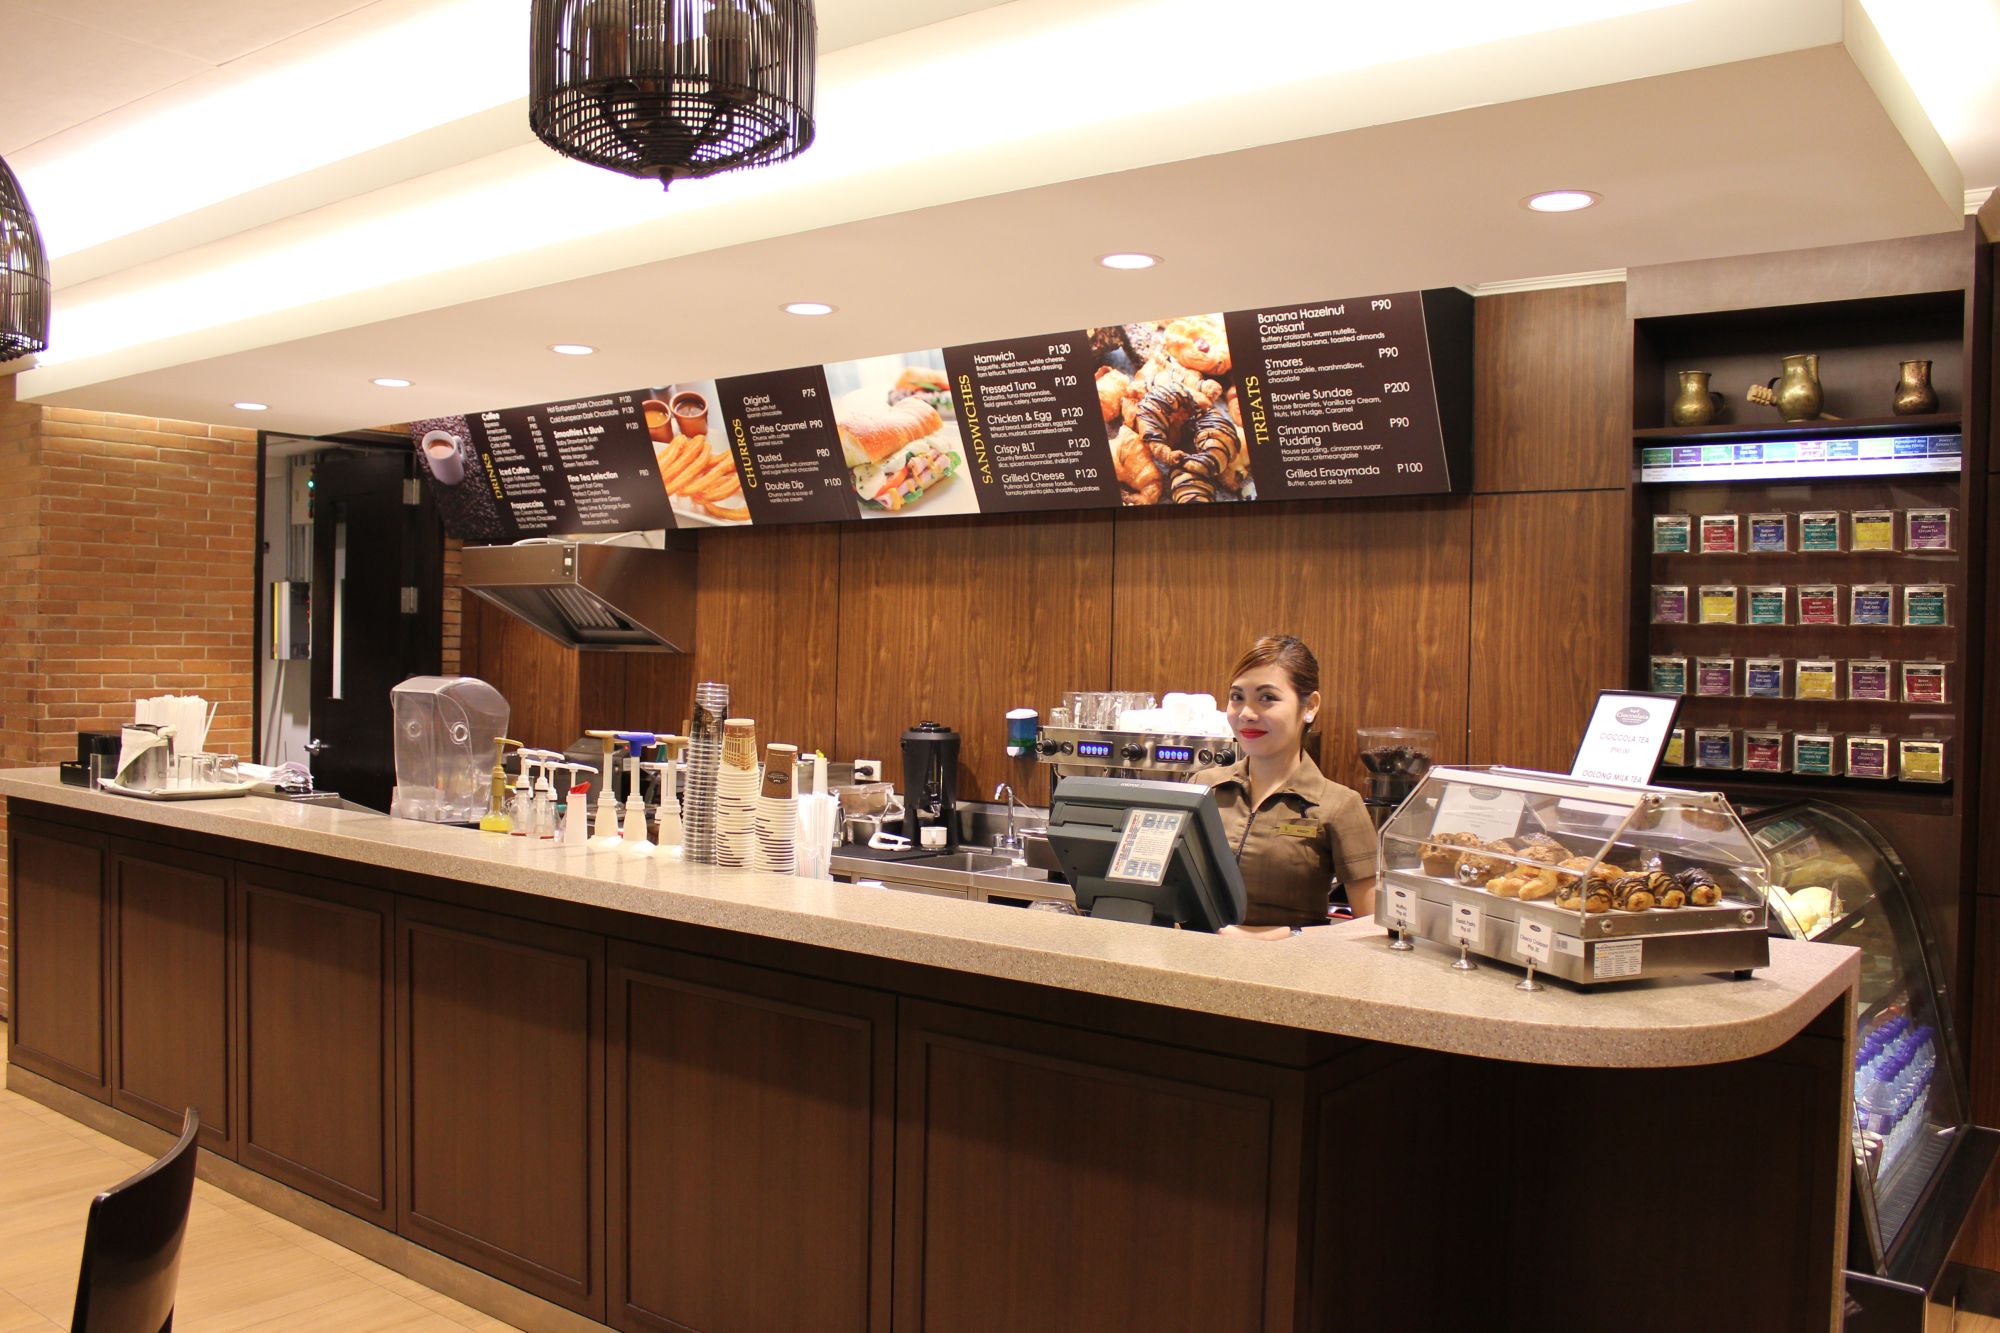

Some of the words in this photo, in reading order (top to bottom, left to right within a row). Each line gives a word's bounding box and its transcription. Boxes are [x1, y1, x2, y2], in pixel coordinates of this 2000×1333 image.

[1258, 311, 1297, 324] Banana
[1300, 304, 1344, 319] Hazelnut
[1371, 299, 1391, 311] P90
[1260, 321, 1304, 335] Croissant
[1261, 335, 1282, 343] Buttery
[1283, 332, 1312, 340] croissant,
[1262, 341, 1300, 350] caramelized
[1302, 338, 1330, 346] banana,
[1330, 335, 1355, 343] toasted
[1356, 332, 1385, 341] almonds
[974, 351, 1015, 364] Hamwich
[1048, 344, 1070, 355] P130
[1265, 358, 1303, 369] S'mores
[1378, 347, 1398, 358] P90
[980, 382, 1013, 394] Pressed
[1014, 382, 1036, 391] Tuna
[1055, 376, 1077, 386] P120
[1268, 375, 1300, 383] chocolate
[743, 394, 770, 406] Original
[802, 388, 816, 398] P75
[1271, 391, 1310, 402] Brownie
[1313, 388, 1353, 399] Sundae
[1384, 382, 1410, 393] P200
[547, 406, 555, 414] Hot
[556, 404, 576, 412] European
[588, 399, 613, 407] Chocolate
[594, 409, 619, 417] Chocolate
[1246, 376, 1269, 444] TREATS
[1302, 408, 1324, 416] Fudge,
[1325, 406, 1353, 414] Caramel
[482, 412, 500, 421] Coffee
[987, 414, 1024, 424] Chicken
[1025, 412, 1032, 421] &
[1034, 411, 1052, 422] Egg
[1061, 407, 1083, 418] P120
[750, 425, 774, 434] Coffee
[775, 420, 807, 431] Caramel
[809, 420, 823, 428] P90
[959, 375, 993, 483] SANDWICHES
[1278, 424, 1330, 436] Cinnamon
[1332, 420, 1363, 431] Bread
[1390, 417, 1409, 428] P90
[994, 444, 1020, 454] Crispy
[1022, 442, 1035, 452] BLT
[1068, 438, 1090, 448] P120
[1280, 436, 1321, 446] Pudding
[733, 419, 757, 488] CHURROS
[757, 452, 782, 462] Dusted
[816, 448, 830, 457] P80
[1301, 446, 1329, 454] pudding,
[482, 453, 503, 499] DRINKS
[512, 466, 530, 474] Coffee
[591, 472, 619, 480] Selection
[1002, 473, 1029, 483] Grilled
[1031, 471, 1065, 482] Cheese
[1075, 468, 1097, 478] P120
[1286, 469, 1318, 478] Grilled
[1320, 465, 1380, 478] Ensaymada
[1397, 462, 1423, 473] P100
[765, 482, 790, 490] Double
[791, 480, 804, 490] Dip
[824, 478, 842, 486] P100
[1600, 732, 1635, 742] CIOCCOLA
[1582, 770, 1612, 780] OOLONG
[1613, 774, 1628, 782] MILK
